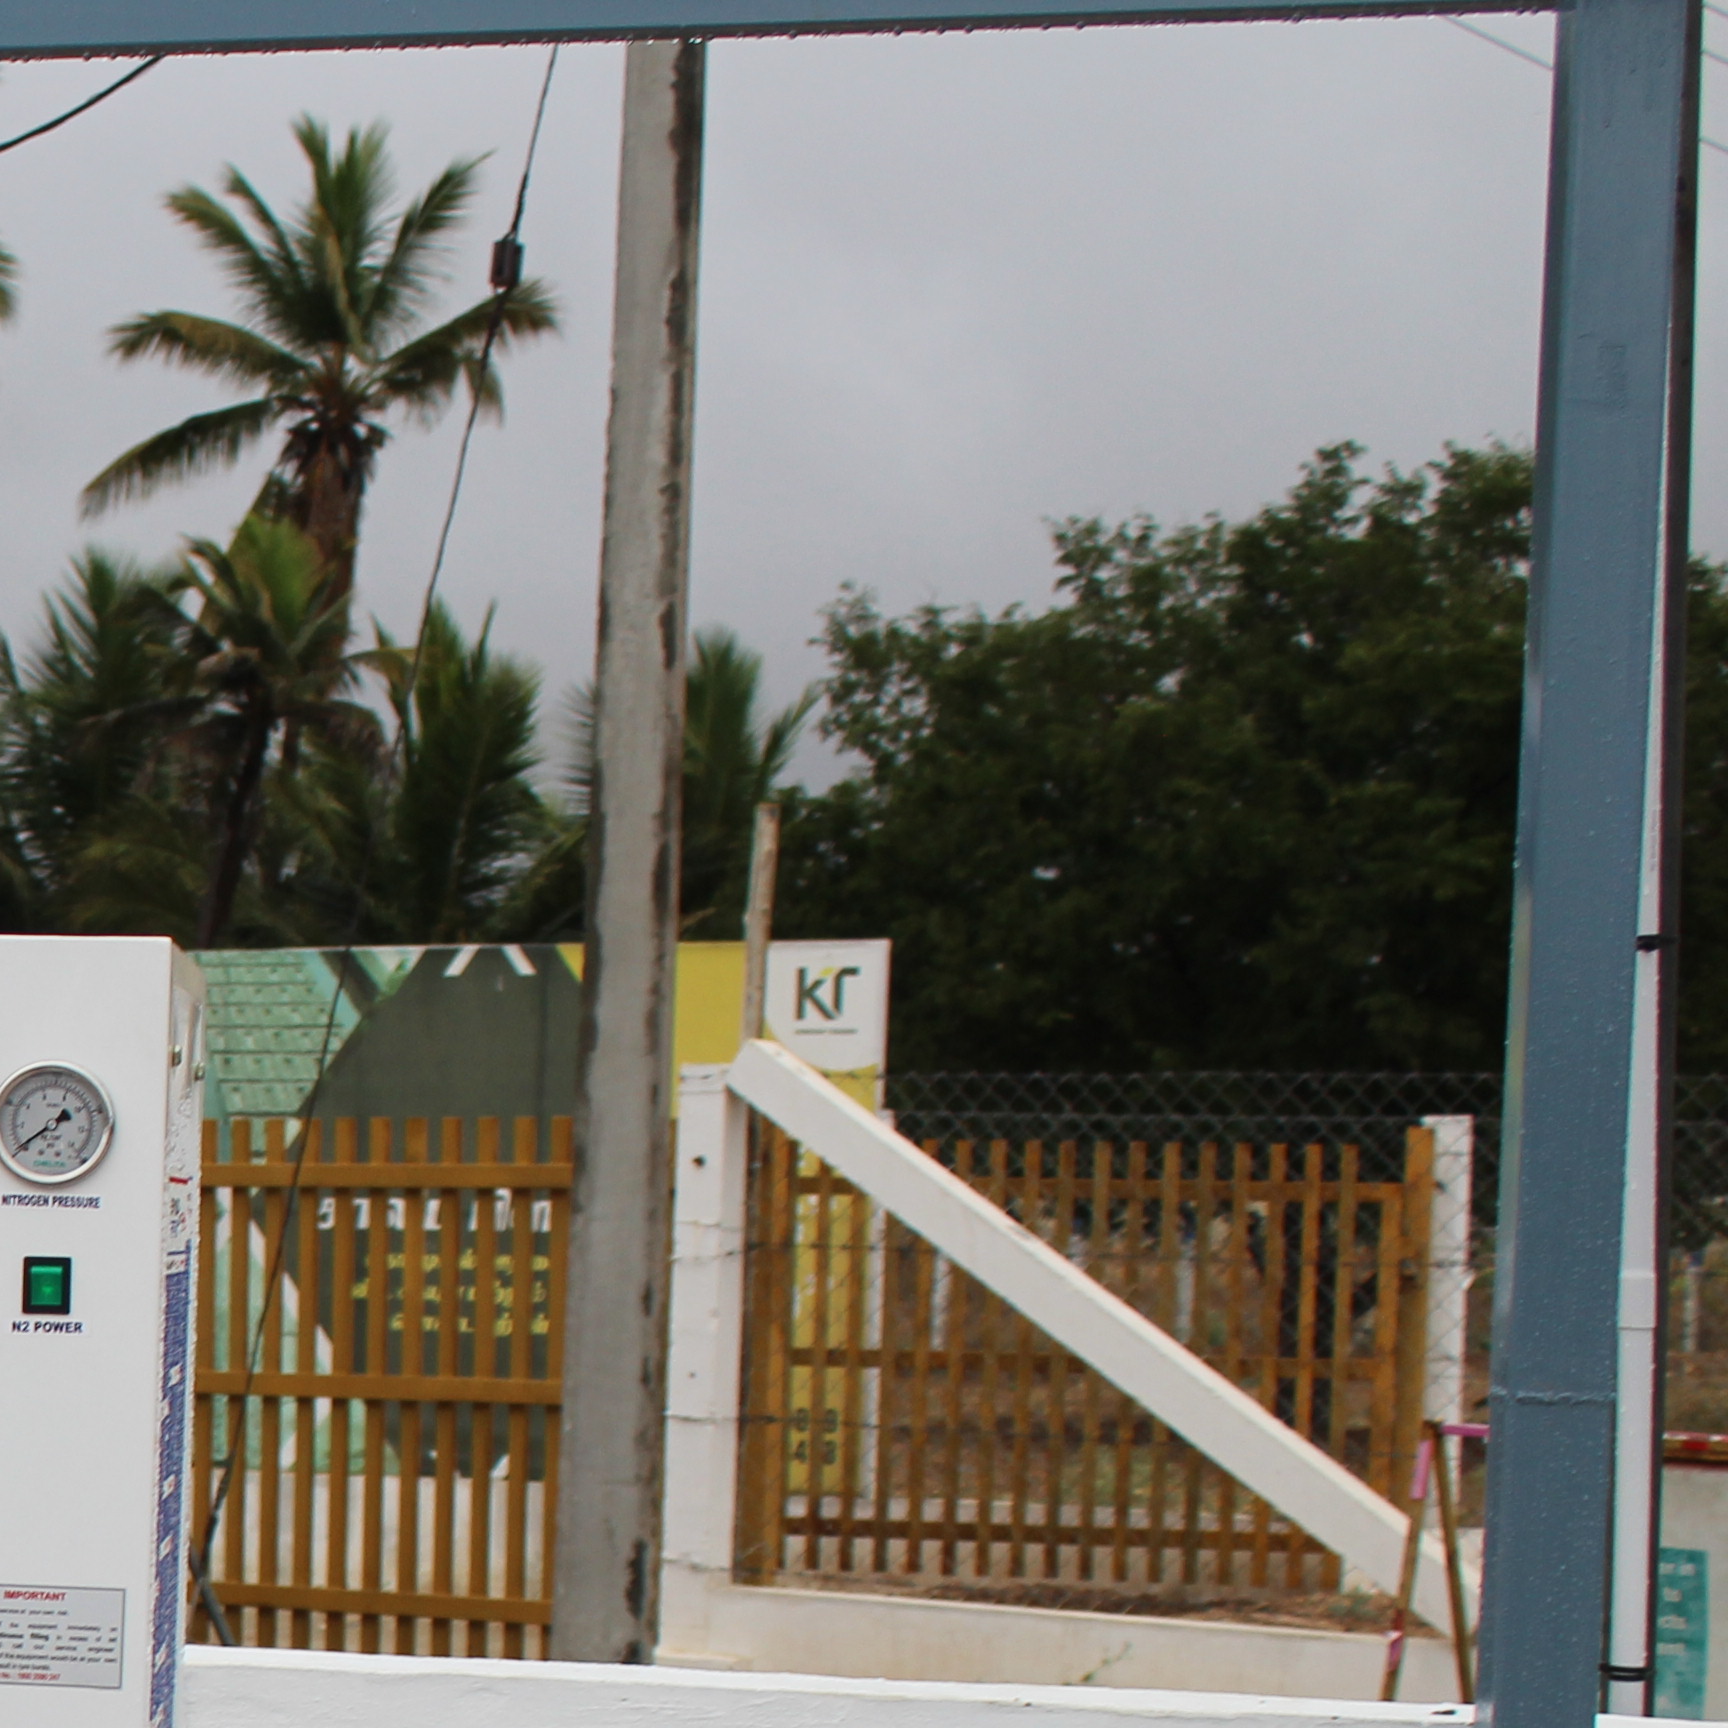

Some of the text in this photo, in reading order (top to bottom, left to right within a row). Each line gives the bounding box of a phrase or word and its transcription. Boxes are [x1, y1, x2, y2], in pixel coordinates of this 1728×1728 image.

[1, 1194, 101, 1208] NITROGEN PRESSURE
[12, 1321, 83, 1333] N2 POWER
[3, 1589, 67, 1602] IMPORTANT
